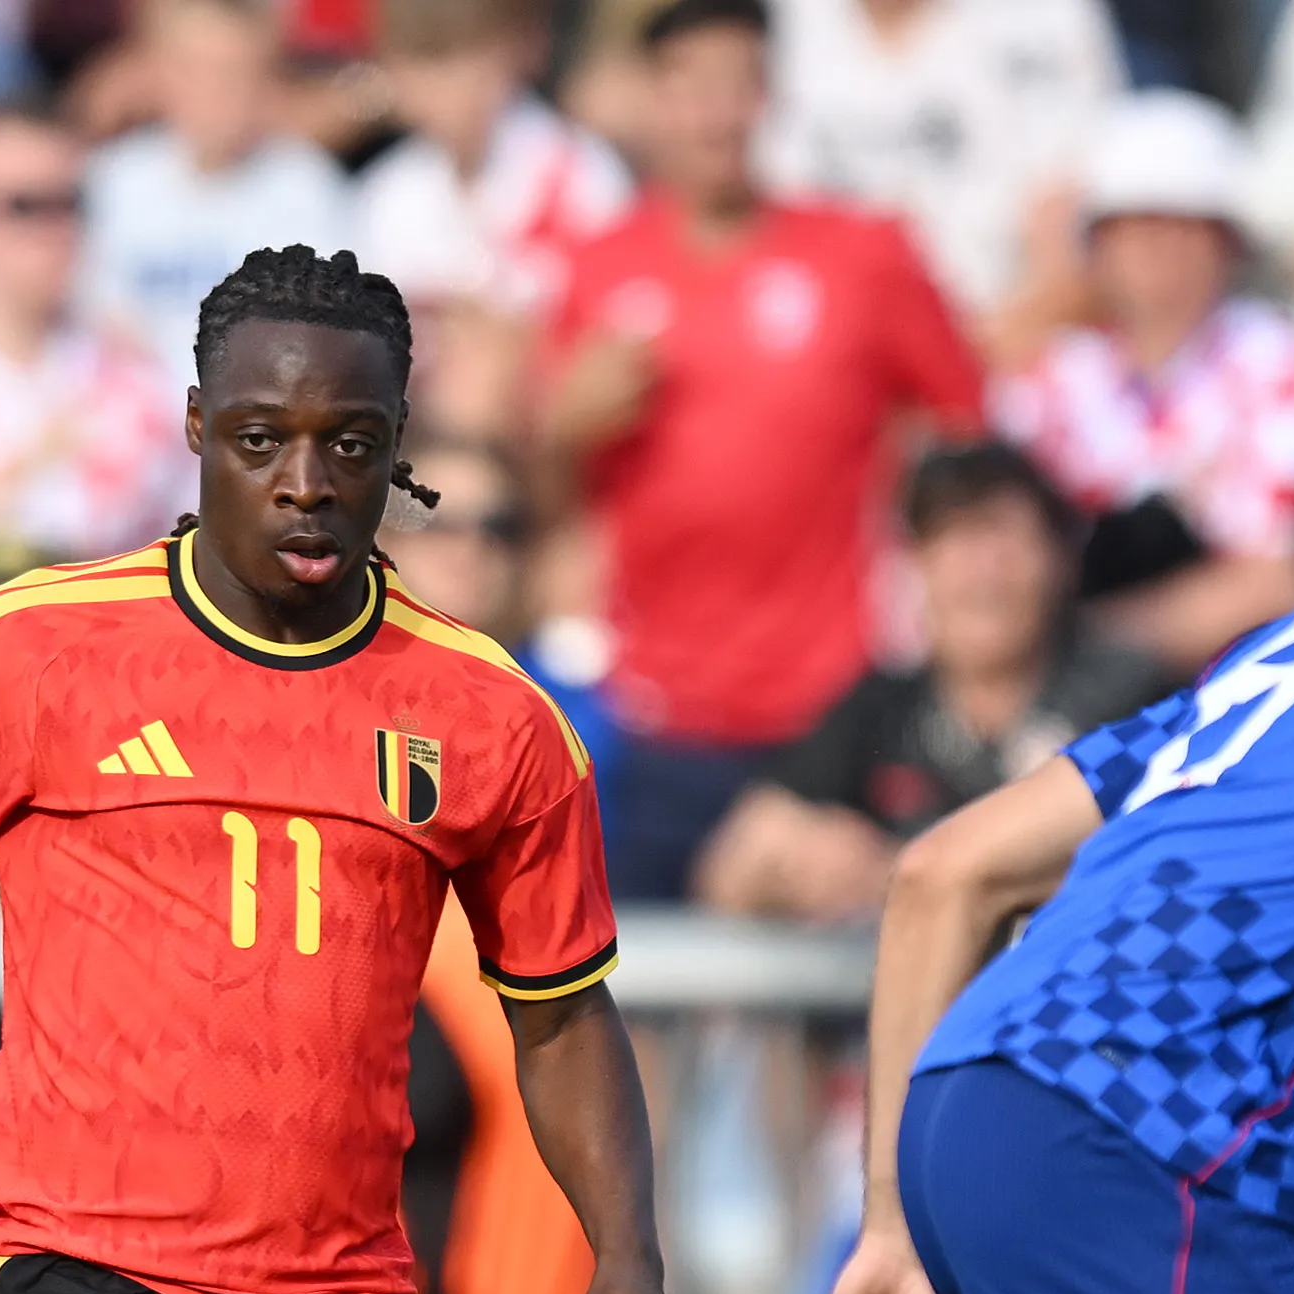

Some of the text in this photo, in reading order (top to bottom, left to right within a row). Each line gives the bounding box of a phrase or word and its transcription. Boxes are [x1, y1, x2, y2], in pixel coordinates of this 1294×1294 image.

[408, 737, 432, 749] ROYAL
[408, 745, 440, 757] BELGIAN
[222, 811, 322, 955] 11
